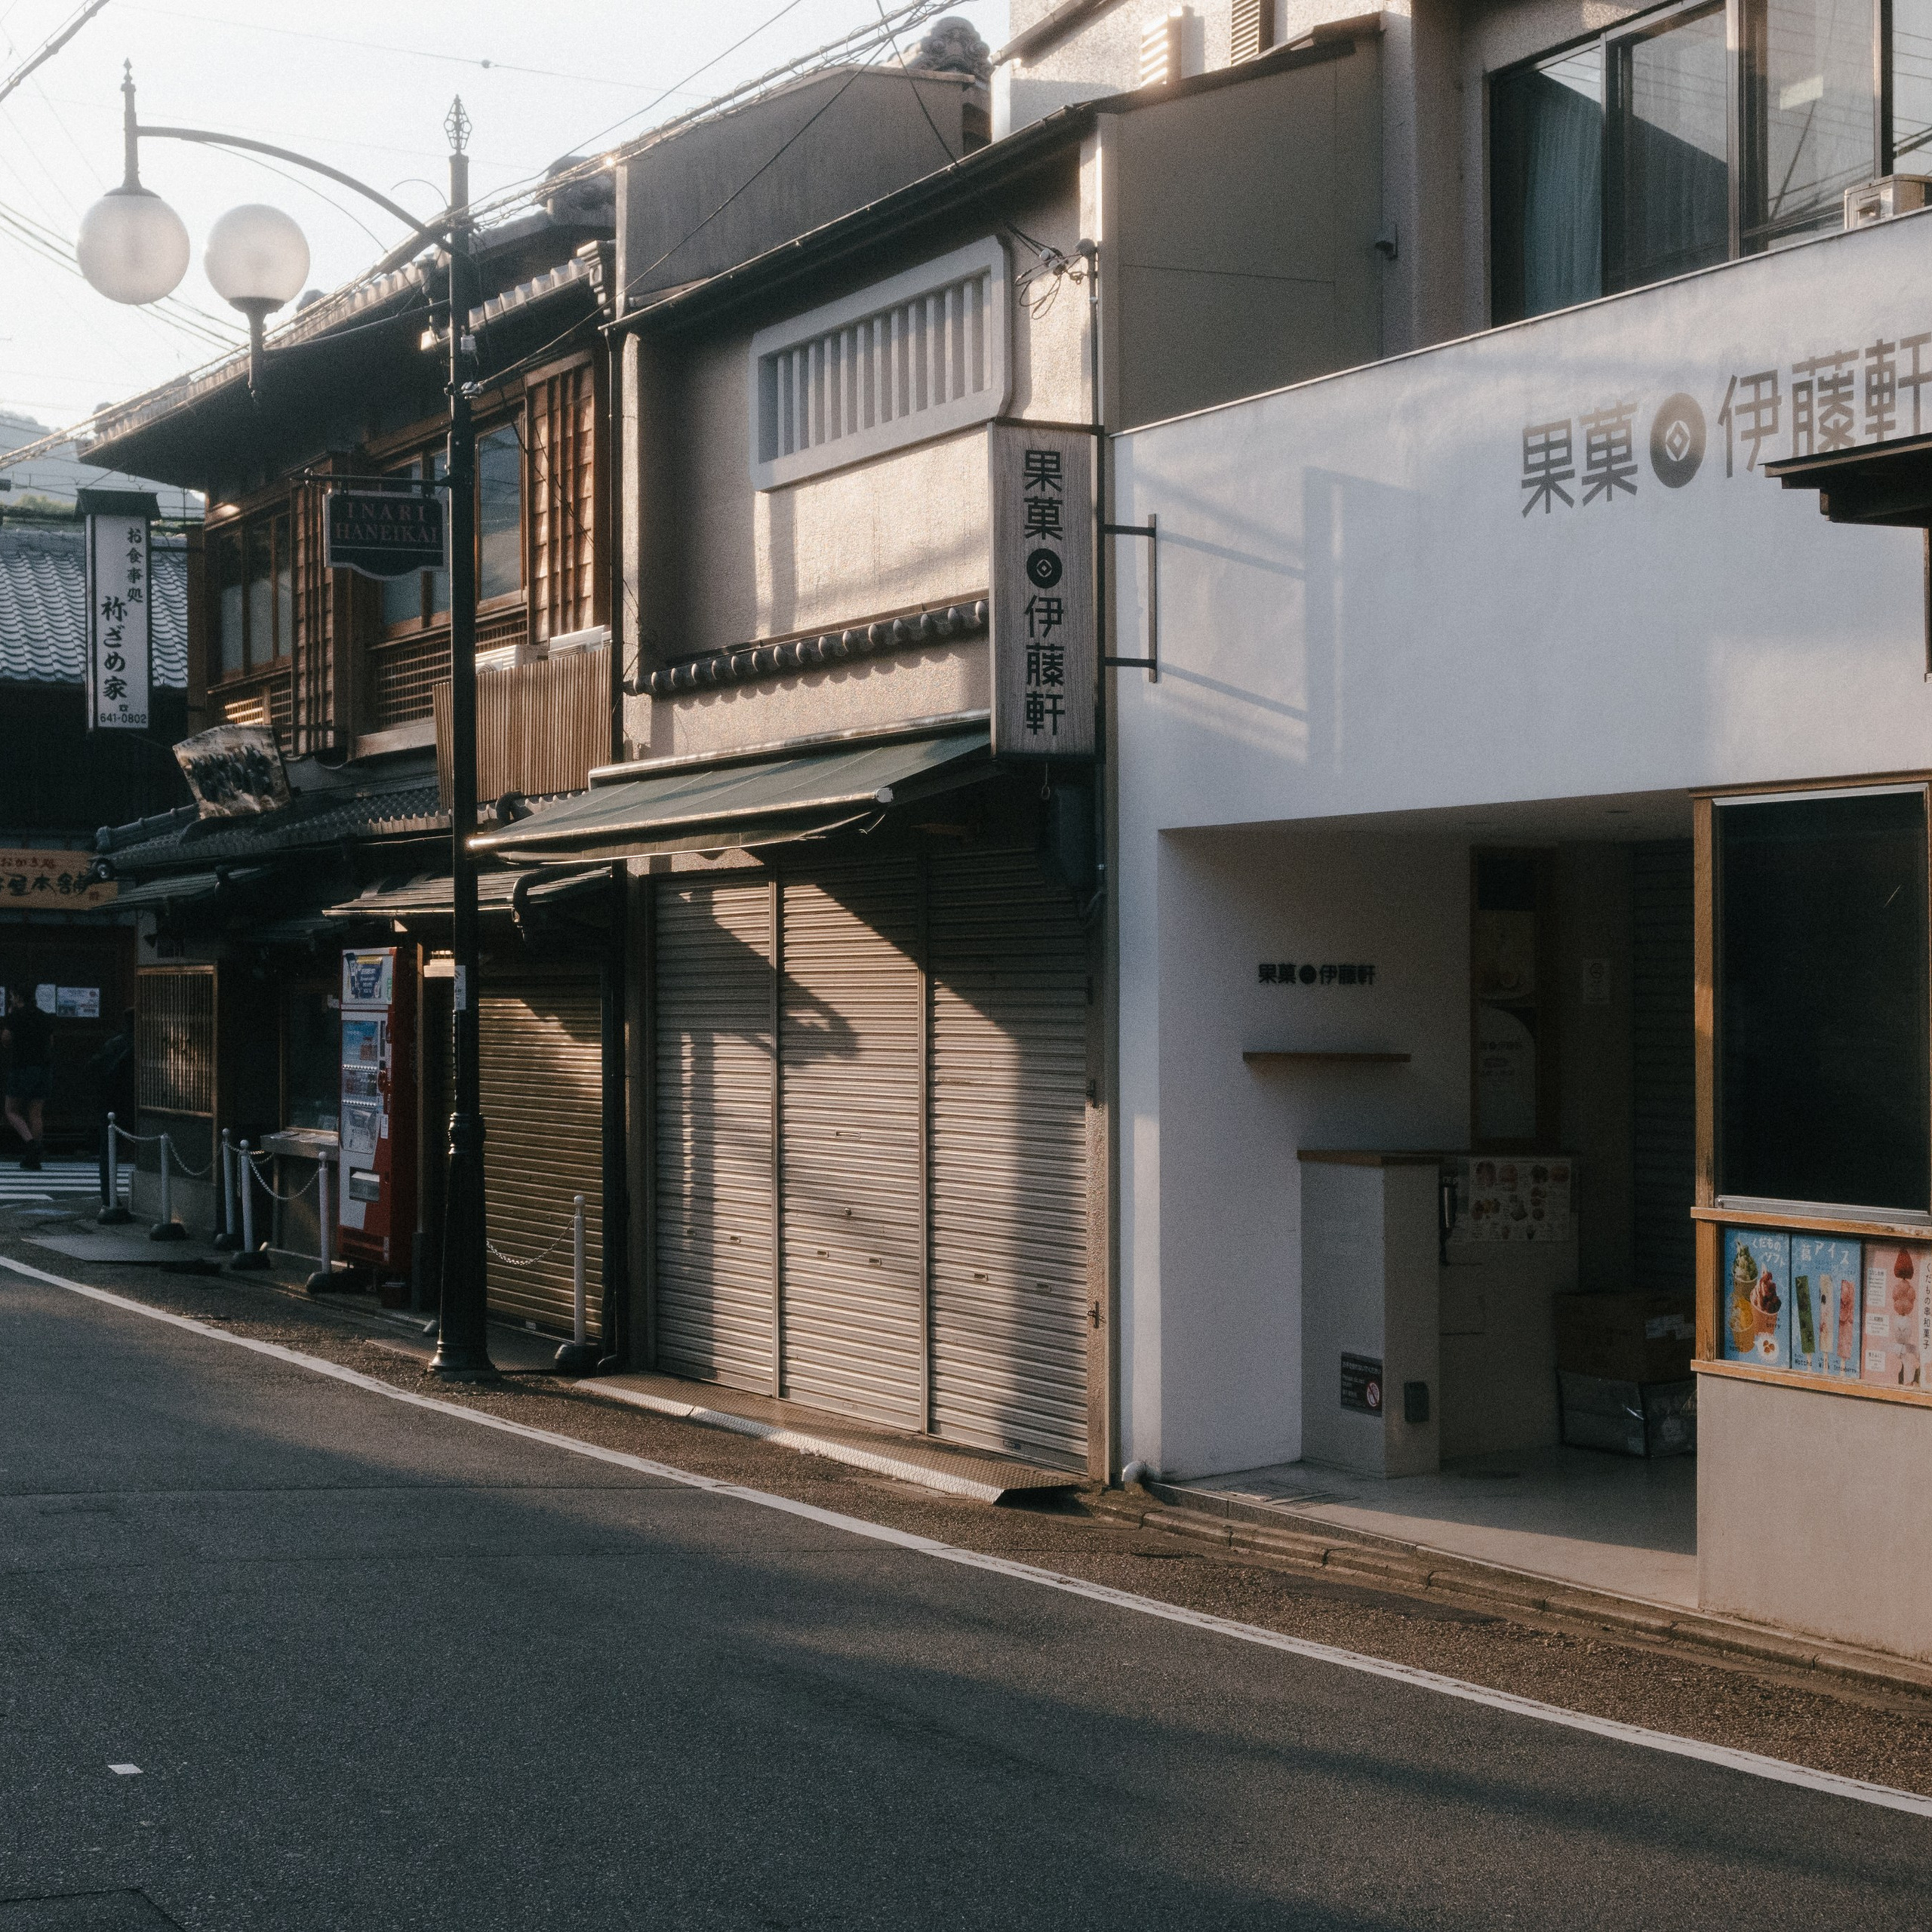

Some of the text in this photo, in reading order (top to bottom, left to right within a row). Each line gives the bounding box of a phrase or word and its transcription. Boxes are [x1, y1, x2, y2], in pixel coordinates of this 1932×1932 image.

[346, 502, 425, 522] INARI
[335, 522, 437, 543] HANEIKAI
[125, 527, 144, 603] お食事処
[1023, 450, 1066, 736] 果菓 伊藤軒
[100, 712, 147, 724] 641-0802
[0, 870, 88, 897] 屋本舗
[1752, 1236, 1781, 1252] くだもの
